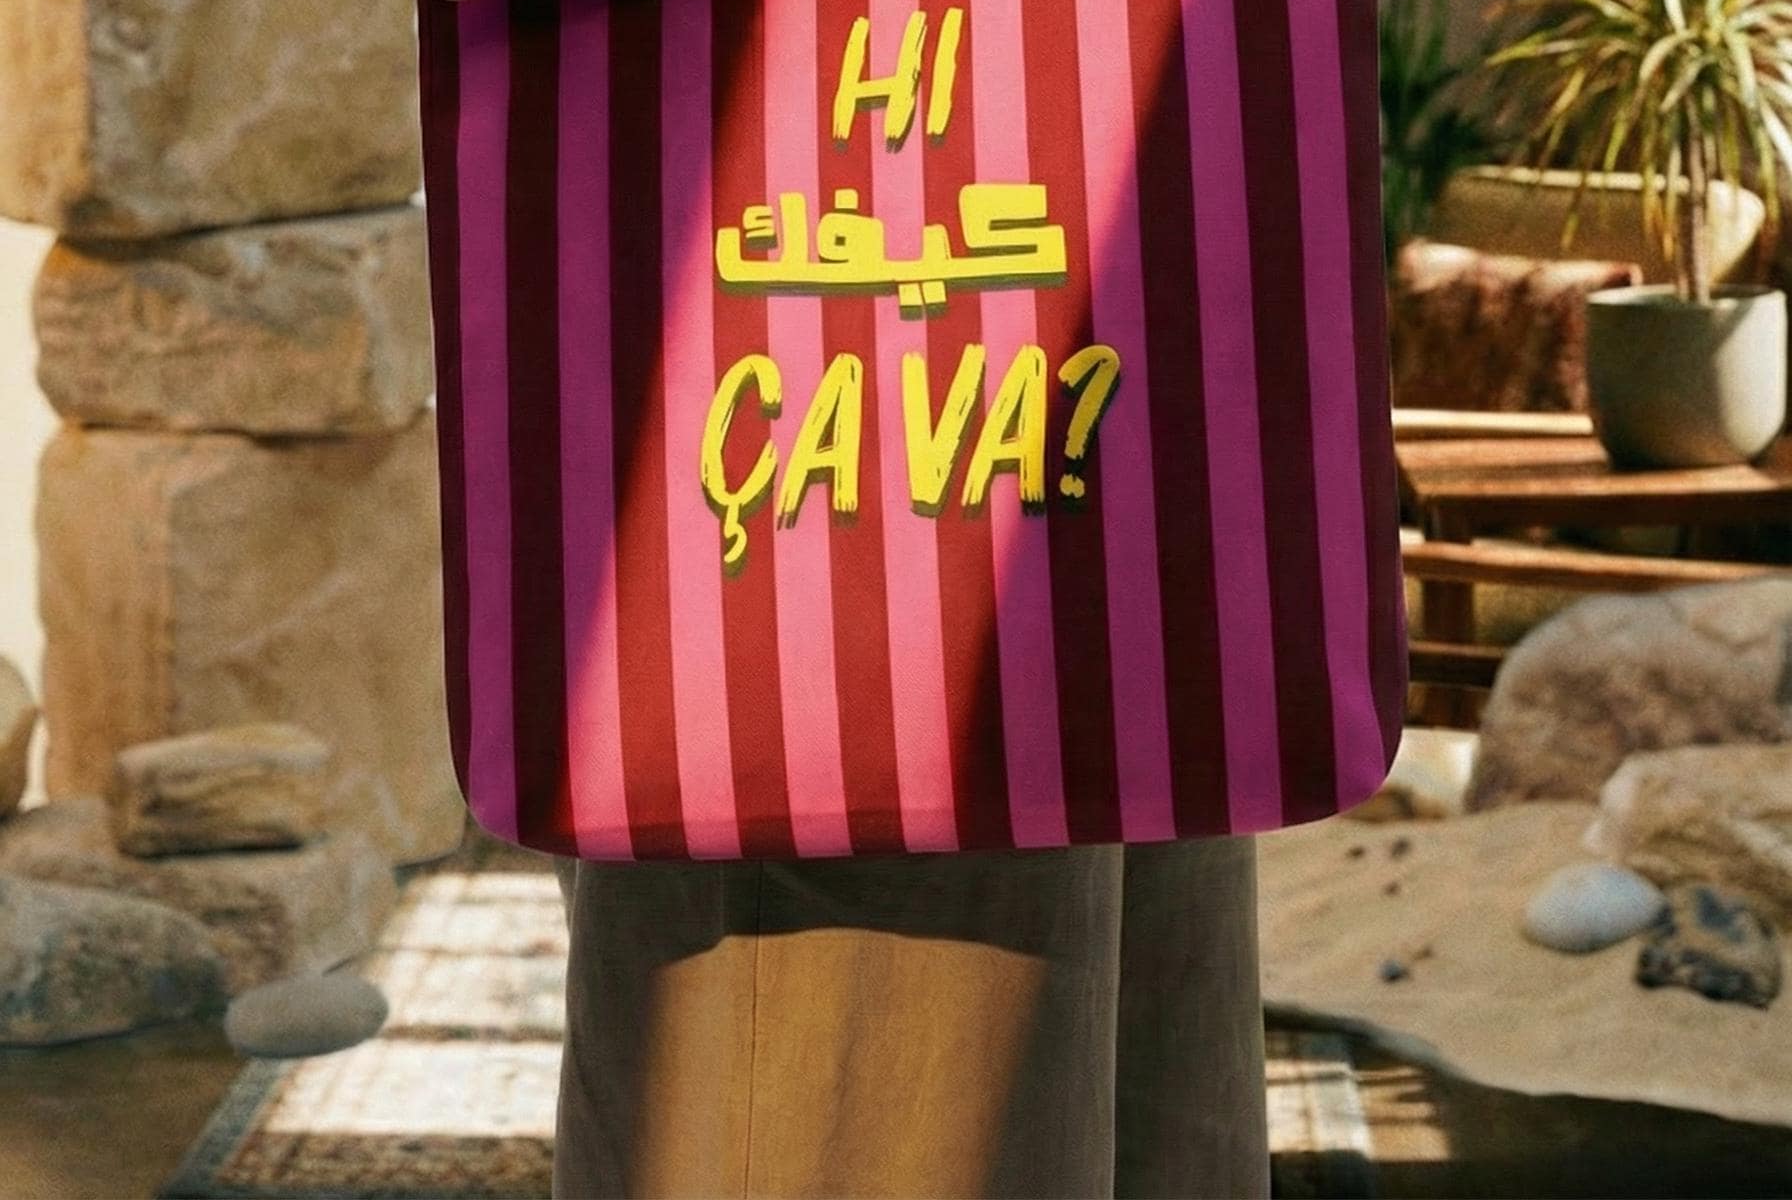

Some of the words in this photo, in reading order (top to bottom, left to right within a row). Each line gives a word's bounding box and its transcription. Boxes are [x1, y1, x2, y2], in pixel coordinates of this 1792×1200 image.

[833, 8, 963, 146] HI
[716, 184, 1067, 316] كيفك
[701, 354, 863, 568] ÇA
[902, 344, 1120, 513] VA?
